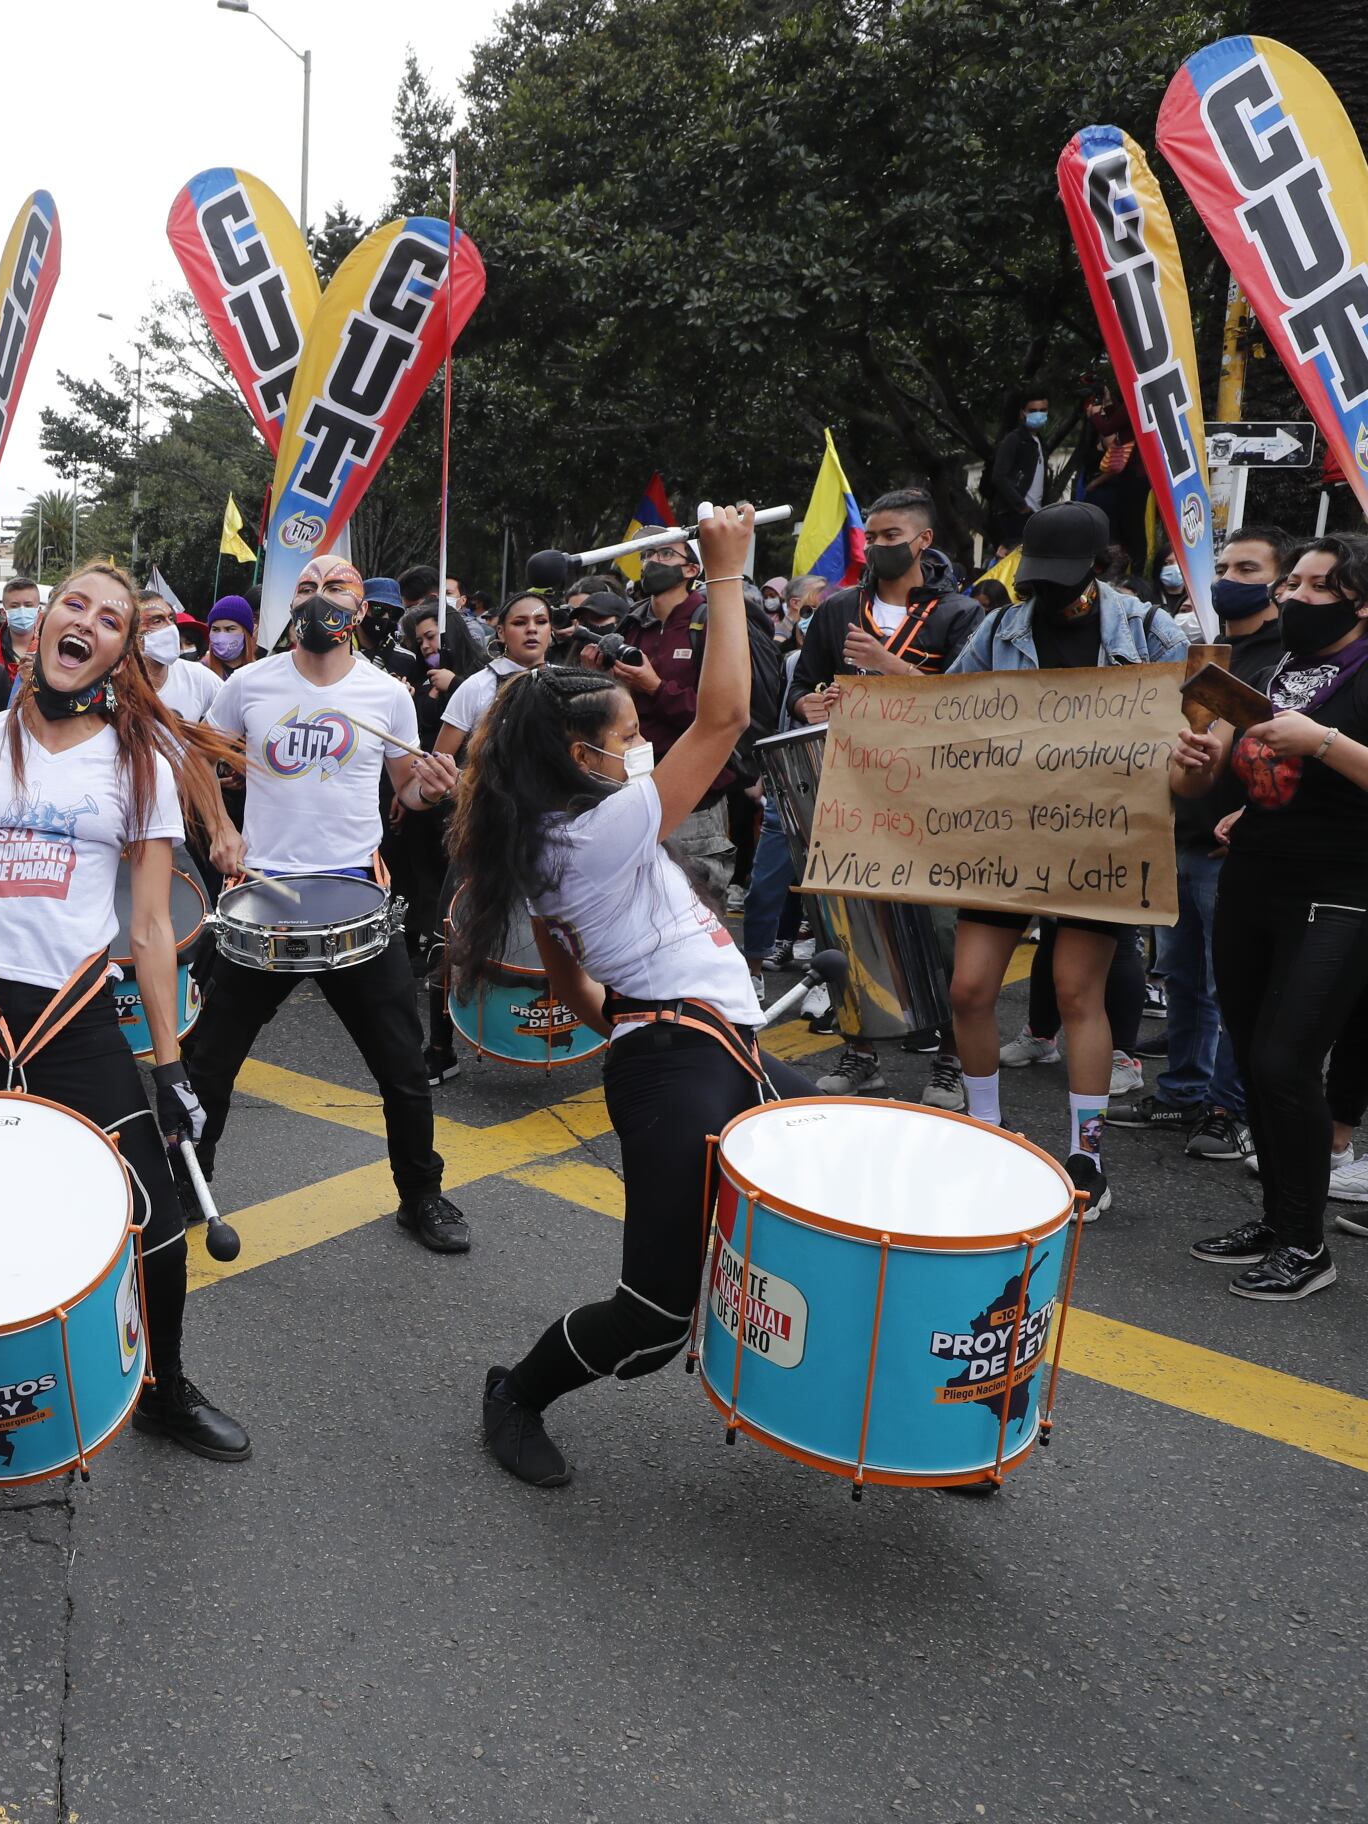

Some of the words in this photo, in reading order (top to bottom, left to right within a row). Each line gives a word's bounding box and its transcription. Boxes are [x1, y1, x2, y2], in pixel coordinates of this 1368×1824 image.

[1201, 54, 1368, 412] CUT
[1083, 147, 1196, 486] CUT
[291, 232, 455, 506] CUT
[839, 683, 871, 719] Mi
[934, 687, 1019, 721] escudo
[931, 738, 1023, 770] libertad
[1035, 740, 1173, 776] construyen
[817, 798, 862, 833] Mis
[1028, 803, 1129, 835] resisten
[11, 861, 67, 883] PARAR
[891, 860, 913, 886] el
[929, 856, 1018, 891] espíritu
[1025, 865, 1050, 893] y
[529, 1018, 550, 1028] DE
[721, 1248, 768, 1302] COMTÉ
[717, 1296, 728, 1325] DE
[719, 1270, 786, 1338] NACIONAL
[996, 1308, 1016, 1321] -10
[932, 1296, 1056, 1356] PROYECTO
[969, 1352, 1007, 1380] DE
[1014, 1327, 1046, 1366] LEY
[943, 1388, 974, 1401] Pliego
[976, 1380, 1006, 1396] Nacion
